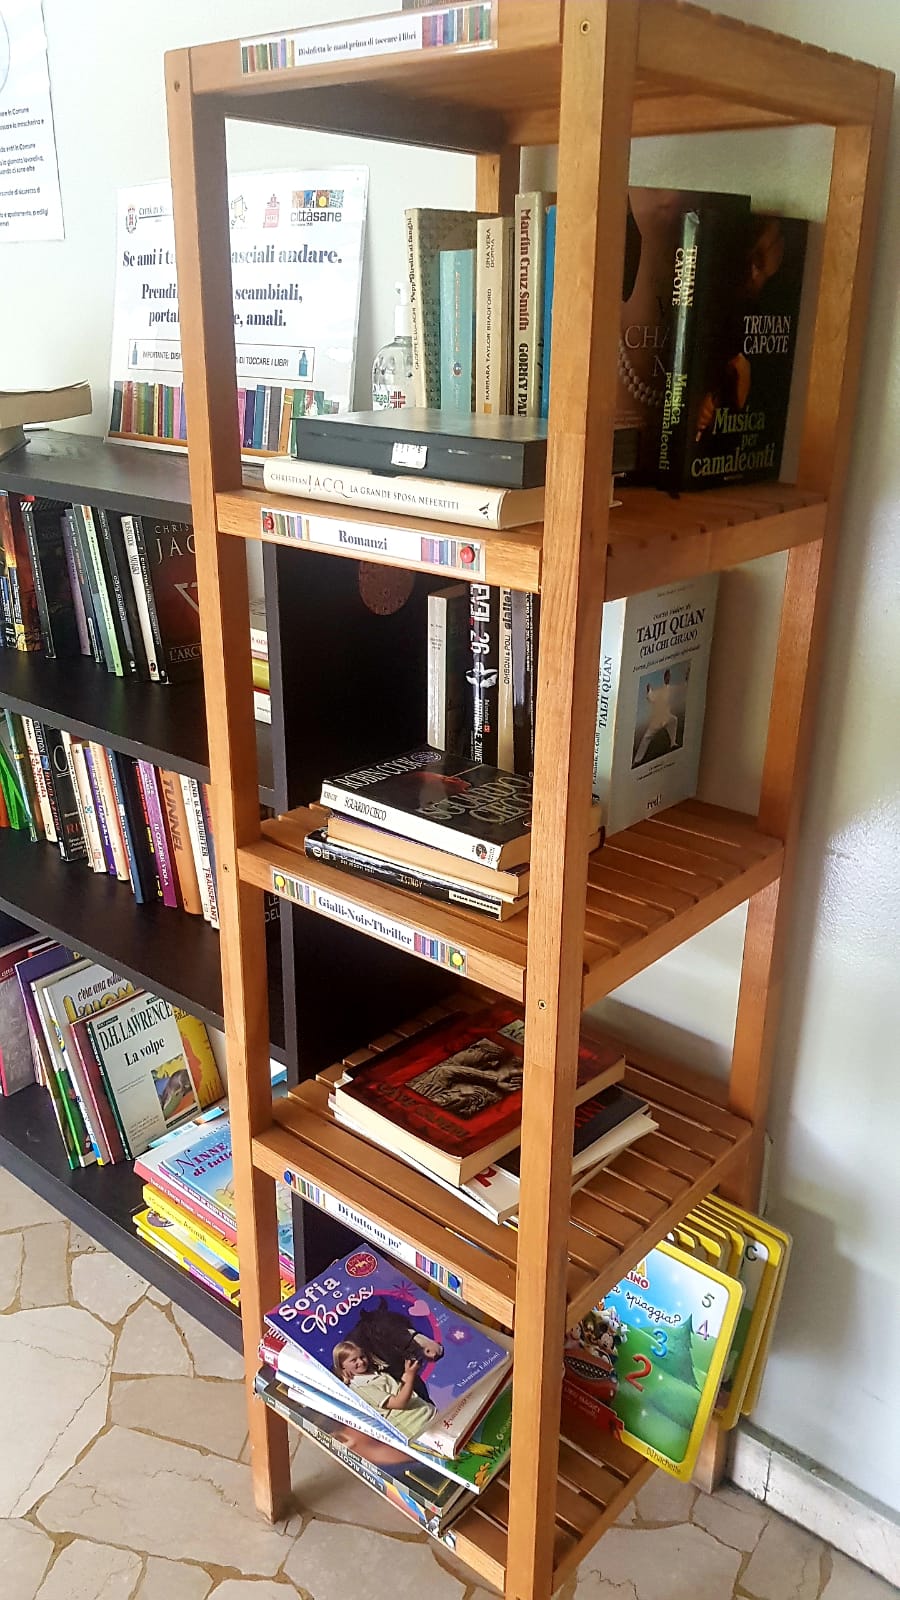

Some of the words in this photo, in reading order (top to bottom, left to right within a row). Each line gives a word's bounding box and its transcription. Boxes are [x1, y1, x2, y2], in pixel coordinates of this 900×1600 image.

[348, 37, 366, 51] prima
[367, 36, 375, 46] di
[375, 35, 398, 46] toccare
[402, 31, 417, 42] libri
[290, 209, 342, 224] cittàsane
[520, 208, 532, 254] Martin
[122, 250, 137, 267] Se
[137, 248, 157, 266] ami
[158, 248, 164, 265] i
[231, 245, 275, 264] asciali
[278, 244, 342, 264] andare.
[519, 257, 531, 290] Cruz
[672, 247, 684, 307] CAPOTE
[685, 246, 698, 308] TRUMAN
[141, 283, 178, 300] Prendi
[234, 284, 303, 302] scambiali,
[148, 308, 180, 327] portal
[246, 309, 287, 327] amali.
[519, 291, 530, 331] Smith
[743, 315, 792, 334] TRUMAN
[245, 356, 270, 366] TOCCARE
[274, 358, 289, 367] LIBRI
[743, 335, 789, 355] CAPOTE
[518, 343, 529, 385] GORKY
[671, 373, 687, 425] Musica
[658, 389, 673, 470] camaleonti
[712, 406, 765, 435] Musica
[741, 432, 759, 450] per
[691, 442, 775, 478] camaleonti
[271, 473, 307, 485] CHRISTIAN
[308, 474, 353, 499] JACQ
[350, 484, 359, 494] LA
[360, 486, 391, 500] GRANDE
[393, 491, 417, 504] SPOSA
[418, 495, 459, 511] NEFERTITI
[154, 524, 193, 535] CHRIS
[338, 529, 388, 551] Romanzi
[155, 535, 196, 565] JAC
[470, 584, 490, 623] EVEL
[470, 630, 490, 655] 26
[636, 616, 666, 644] TAIJI
[669, 608, 706, 637] QUAN
[169, 650, 202, 663] L'ARC
[640, 643, 655, 659] (TAI
[655, 639, 669, 653] CHI
[670, 630, 698, 649] CHUAN)
[602, 656, 613, 693] QUAN
[599, 695, 609, 729] TAIJI
[36, 766, 47, 798] Spada
[163, 779, 183, 852] TUNNEL
[196, 809, 209, 857] SLAUGHTER
[155, 831, 165, 864] COLORE
[161, 864, 169, 886] VIOLA
[203, 868, 218, 922] TRANSPLANT
[318, 896, 412, 945] Gialli-Noir-Thriller
[99, 1028, 122, 1051] D.H.
[122, 1000, 173, 1042] LAWRENCE
[124, 1051, 140, 1067] La
[140, 1038, 165, 1059] volpe
[176, 1142, 228, 1178] NINNE
[193, 1164, 206, 1178] di
[338, 1203, 349, 1217] Di
[350, 1210, 372, 1231] tutto
[373, 1227, 386, 1241] un
[388, 1237, 402, 1250] po'
[745, 1244, 758, 1262] C
[278, 1277, 341, 1322] Sofia
[300, 1285, 373, 1335] Boss
[332, 1290, 343, 1299] e
[626, 1291, 681, 1325] spiaggia?
[701, 1293, 715, 1309] 5
[651, 1330, 669, 1358] 3
[696, 1319, 710, 1341] 4
[625, 1353, 652, 1392] 2
